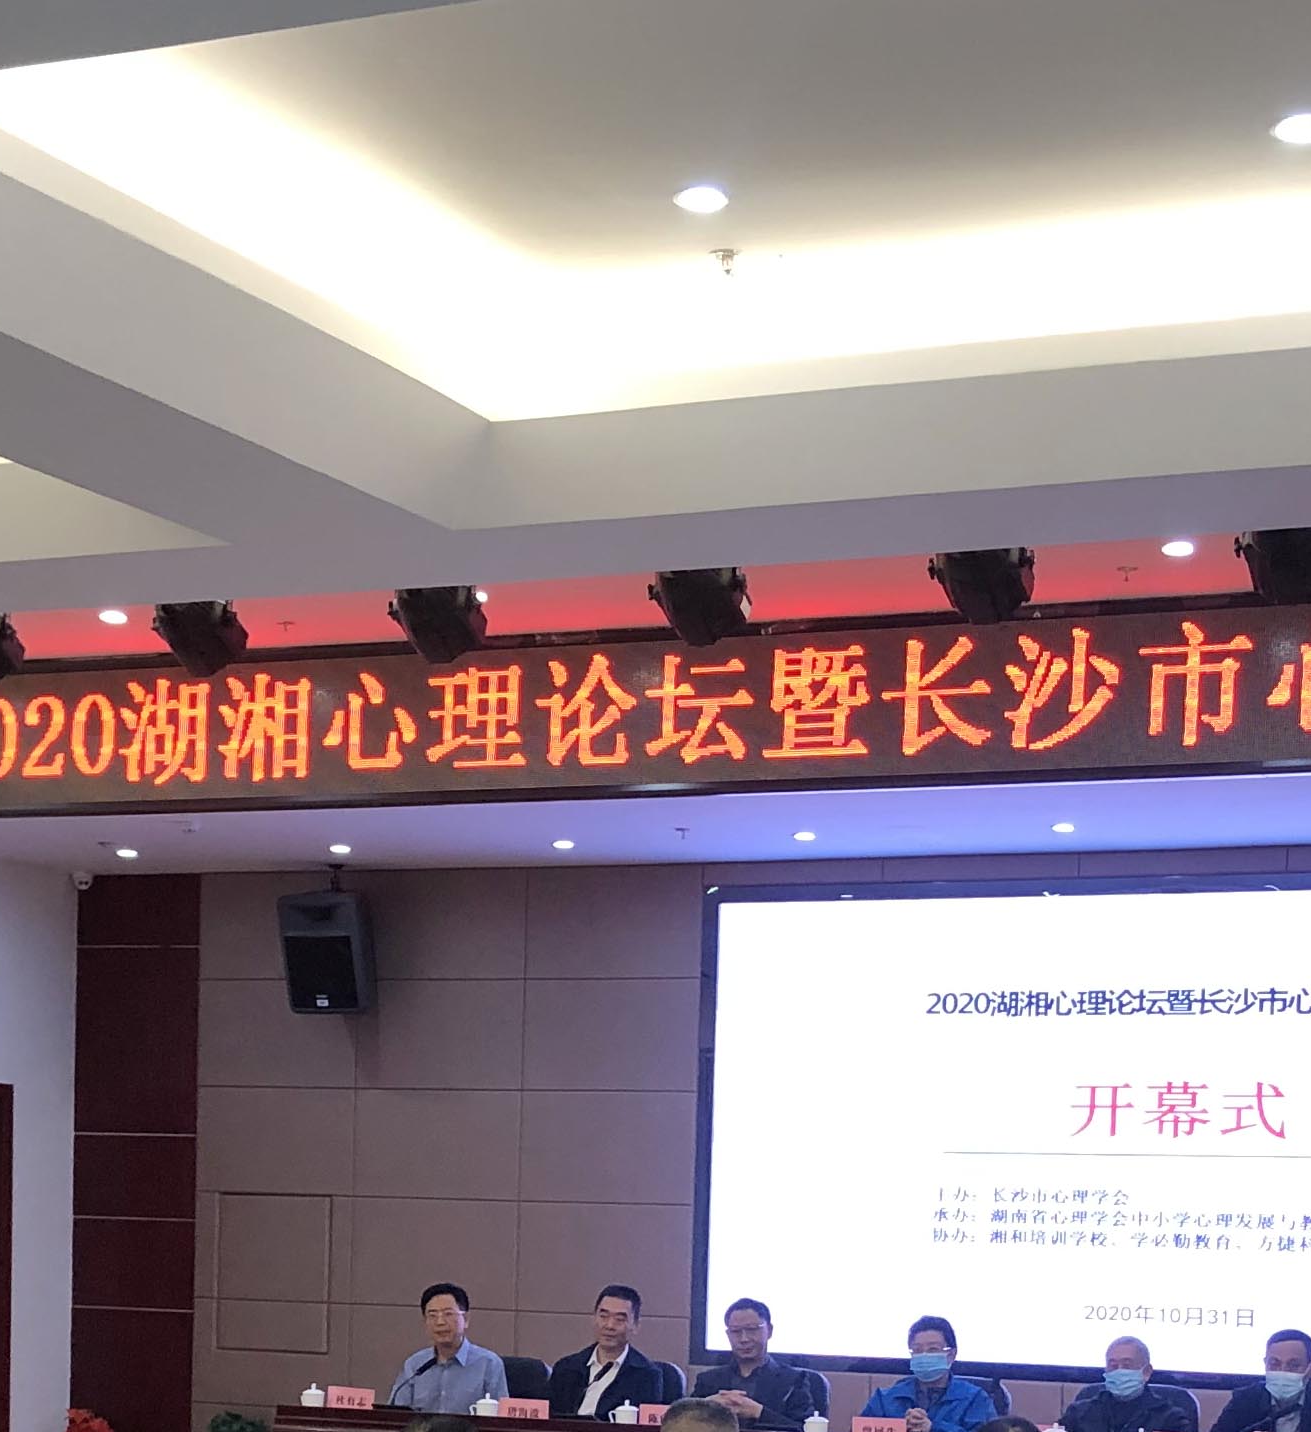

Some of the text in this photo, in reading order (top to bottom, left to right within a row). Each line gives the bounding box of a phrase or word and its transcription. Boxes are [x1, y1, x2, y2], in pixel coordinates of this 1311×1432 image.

[1070, 1081, 1287, 1141] 开幕式
[1083, 1304, 1255, 1328] 2020年10月31日
